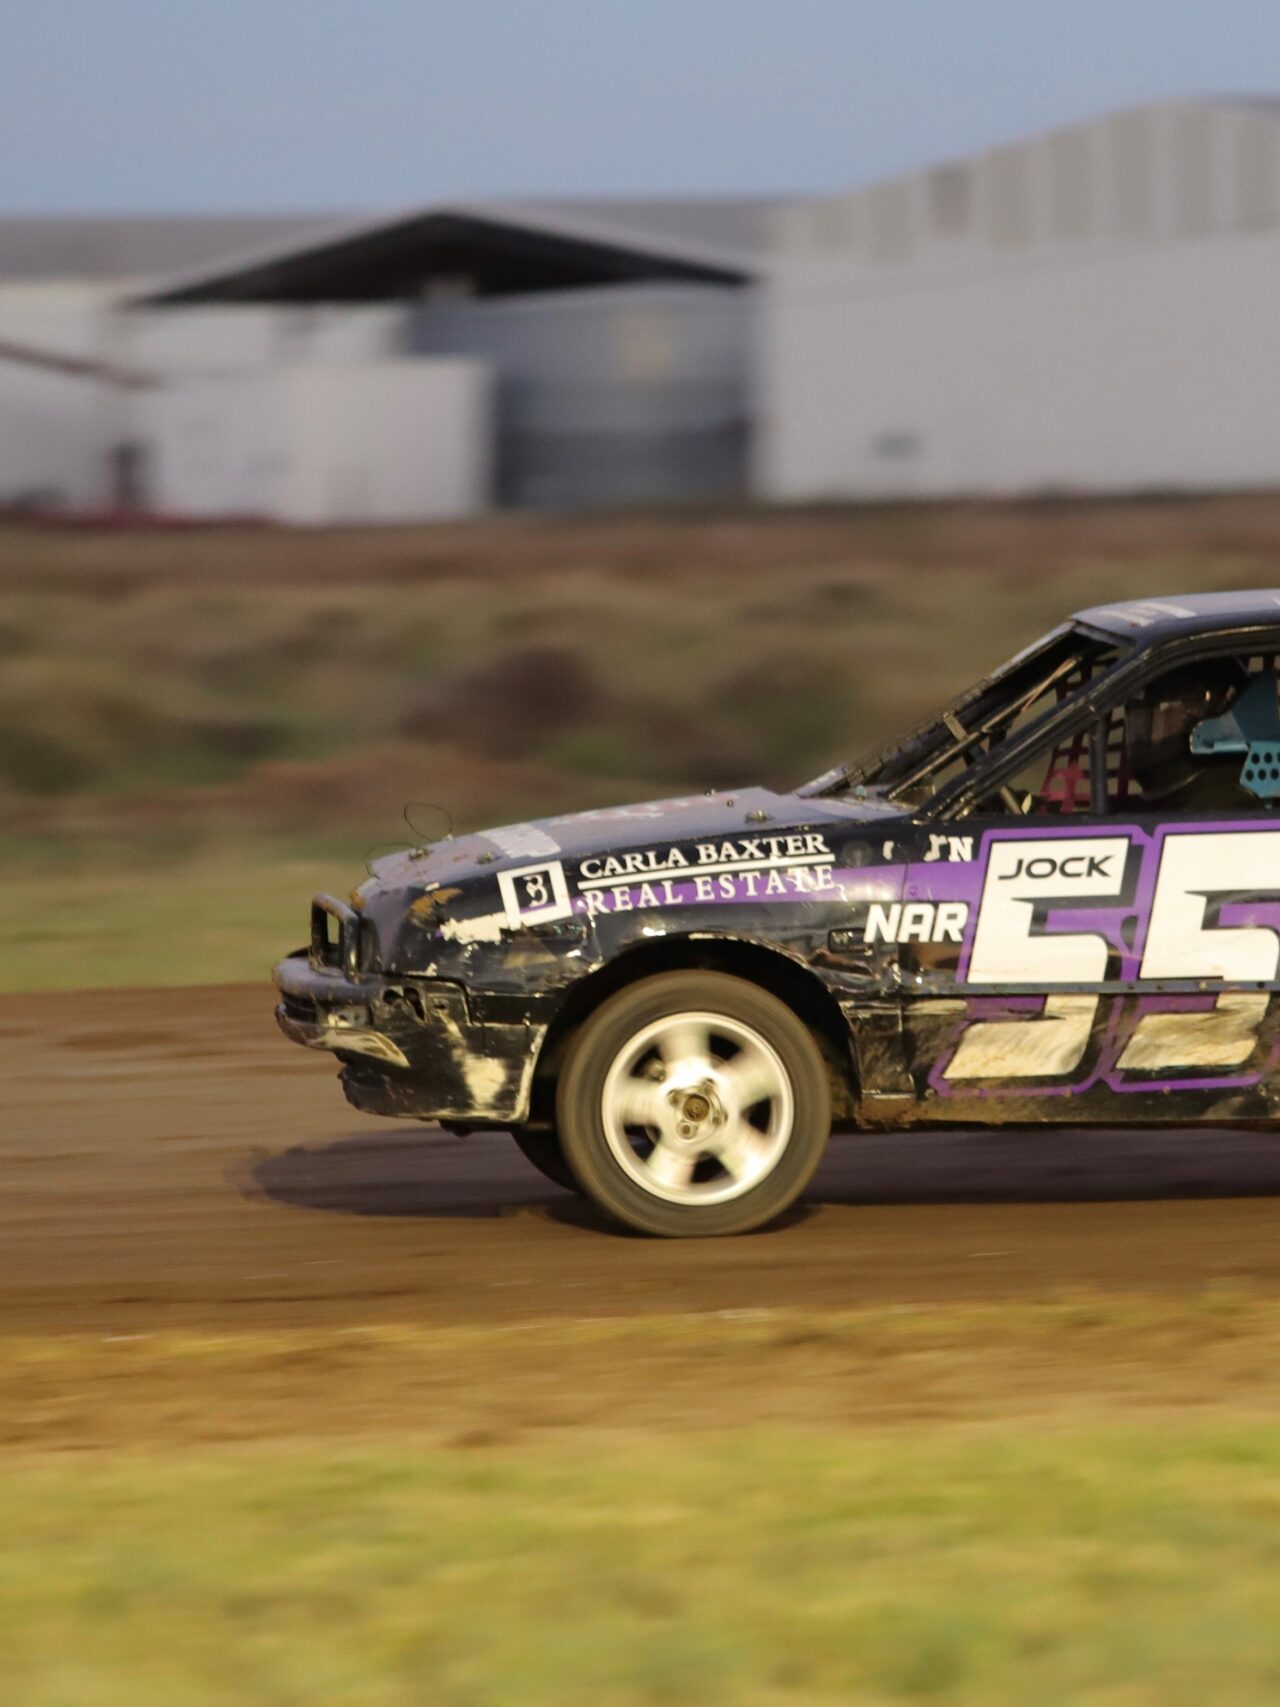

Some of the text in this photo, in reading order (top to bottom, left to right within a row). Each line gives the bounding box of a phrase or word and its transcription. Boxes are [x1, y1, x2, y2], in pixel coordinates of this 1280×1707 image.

[579, 833, 830, 879] CARLA BAXTER
[997, 855, 1115, 881] JOCK
[584, 865, 835, 915] REAL ESTATE
[863, 903, 969, 943] NAR
